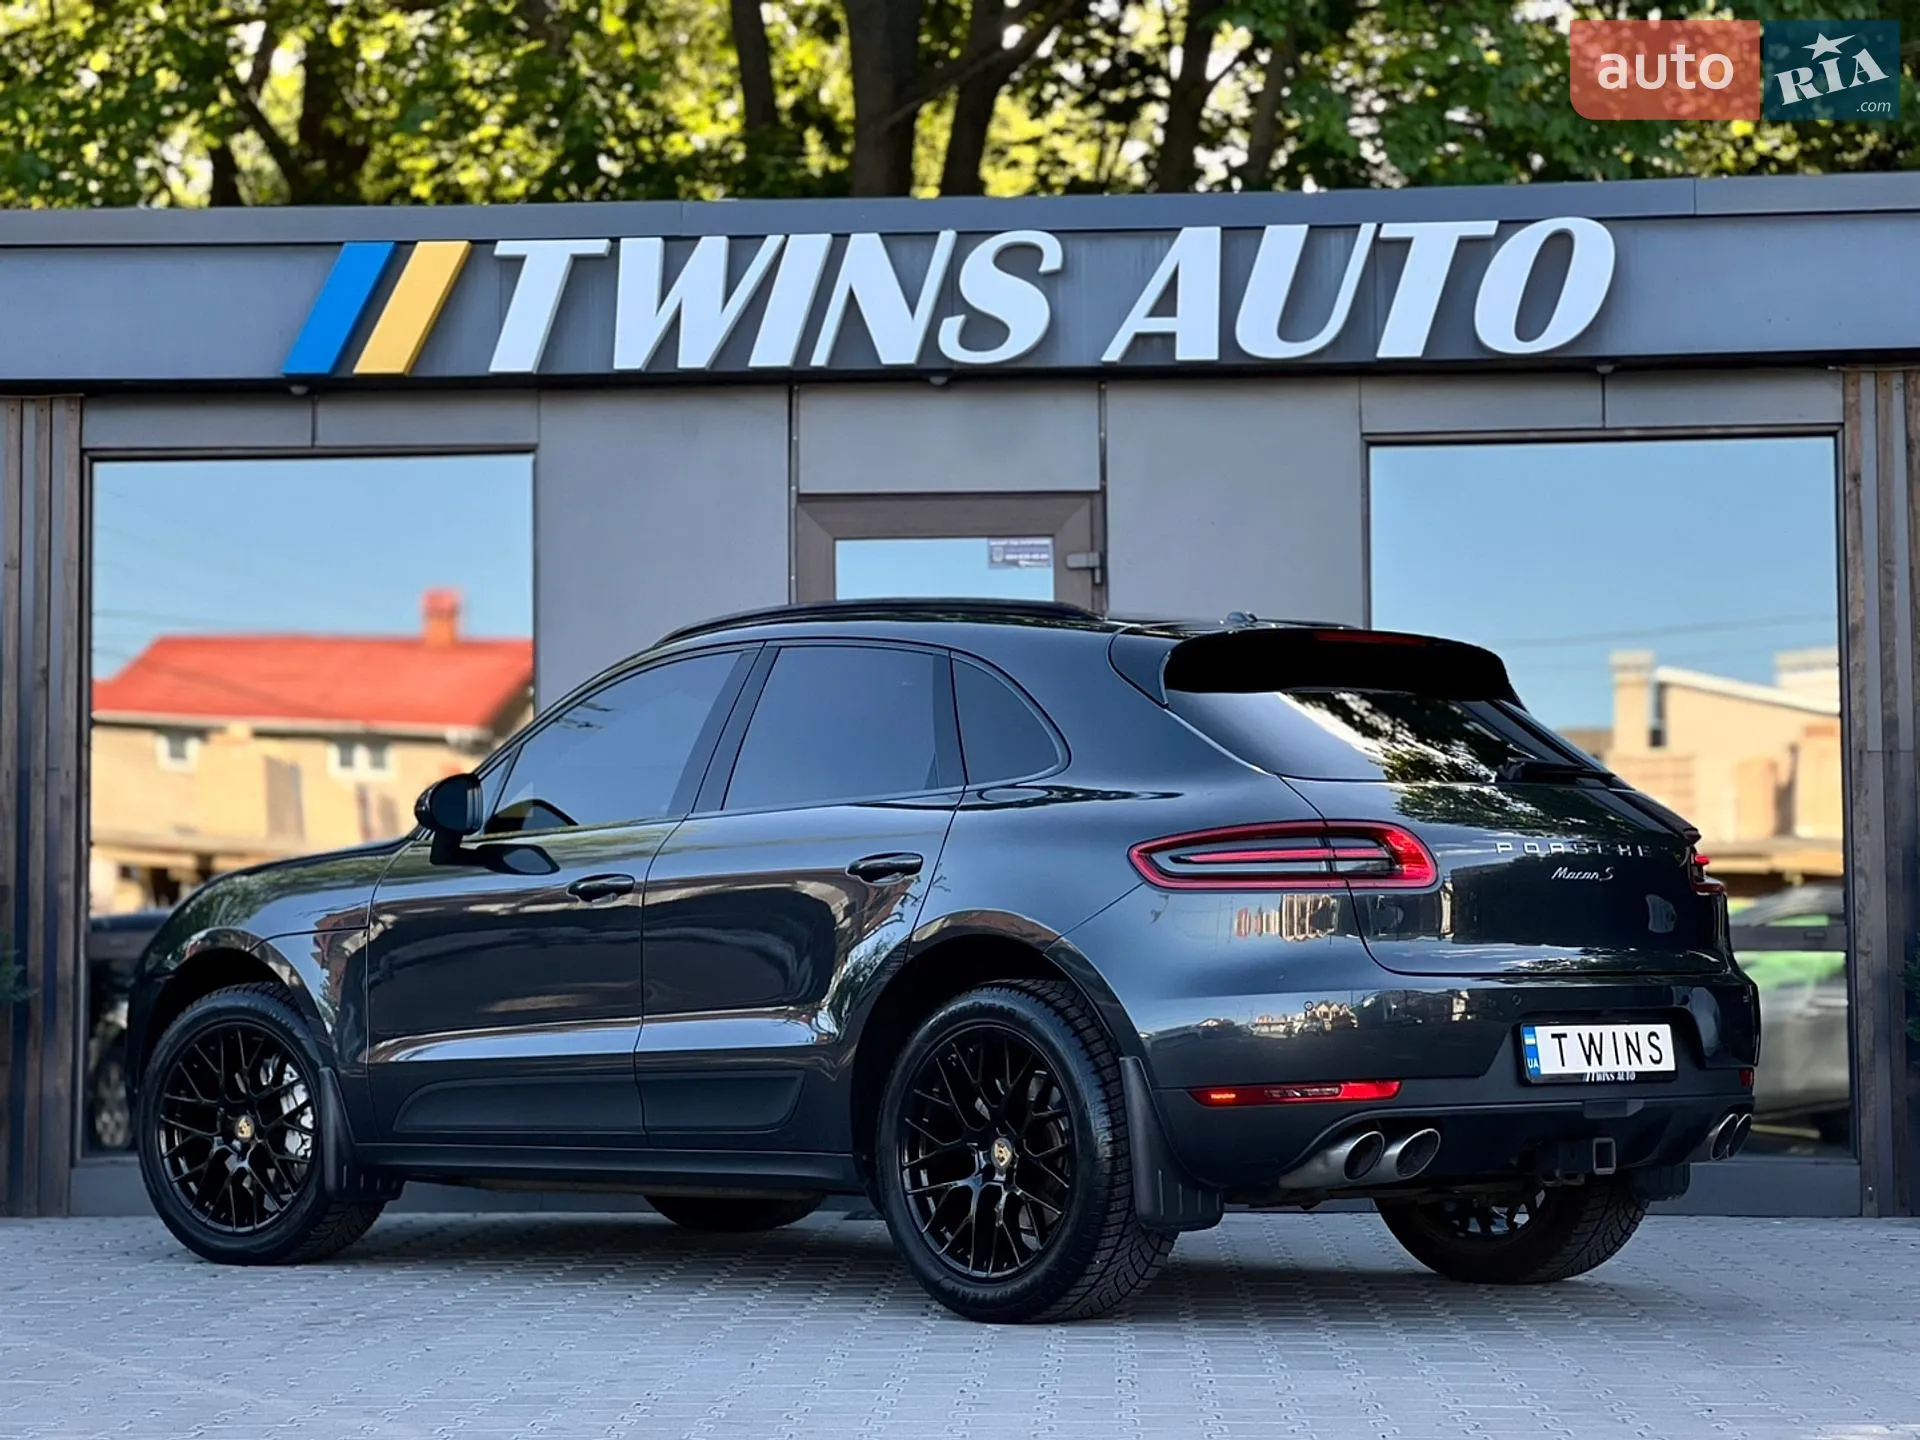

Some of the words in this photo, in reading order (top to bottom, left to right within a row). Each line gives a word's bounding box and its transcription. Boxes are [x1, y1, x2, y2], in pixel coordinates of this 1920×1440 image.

[488, 229, 1064, 374] TWINS
[1100, 216, 1616, 364] AUTO
[1551, 866, 1599, 880] Macan
[1599, 866, 1615, 882] S
[1551, 1031, 1663, 1067] TWINS
[1527, 1057, 1540, 1069] UA
